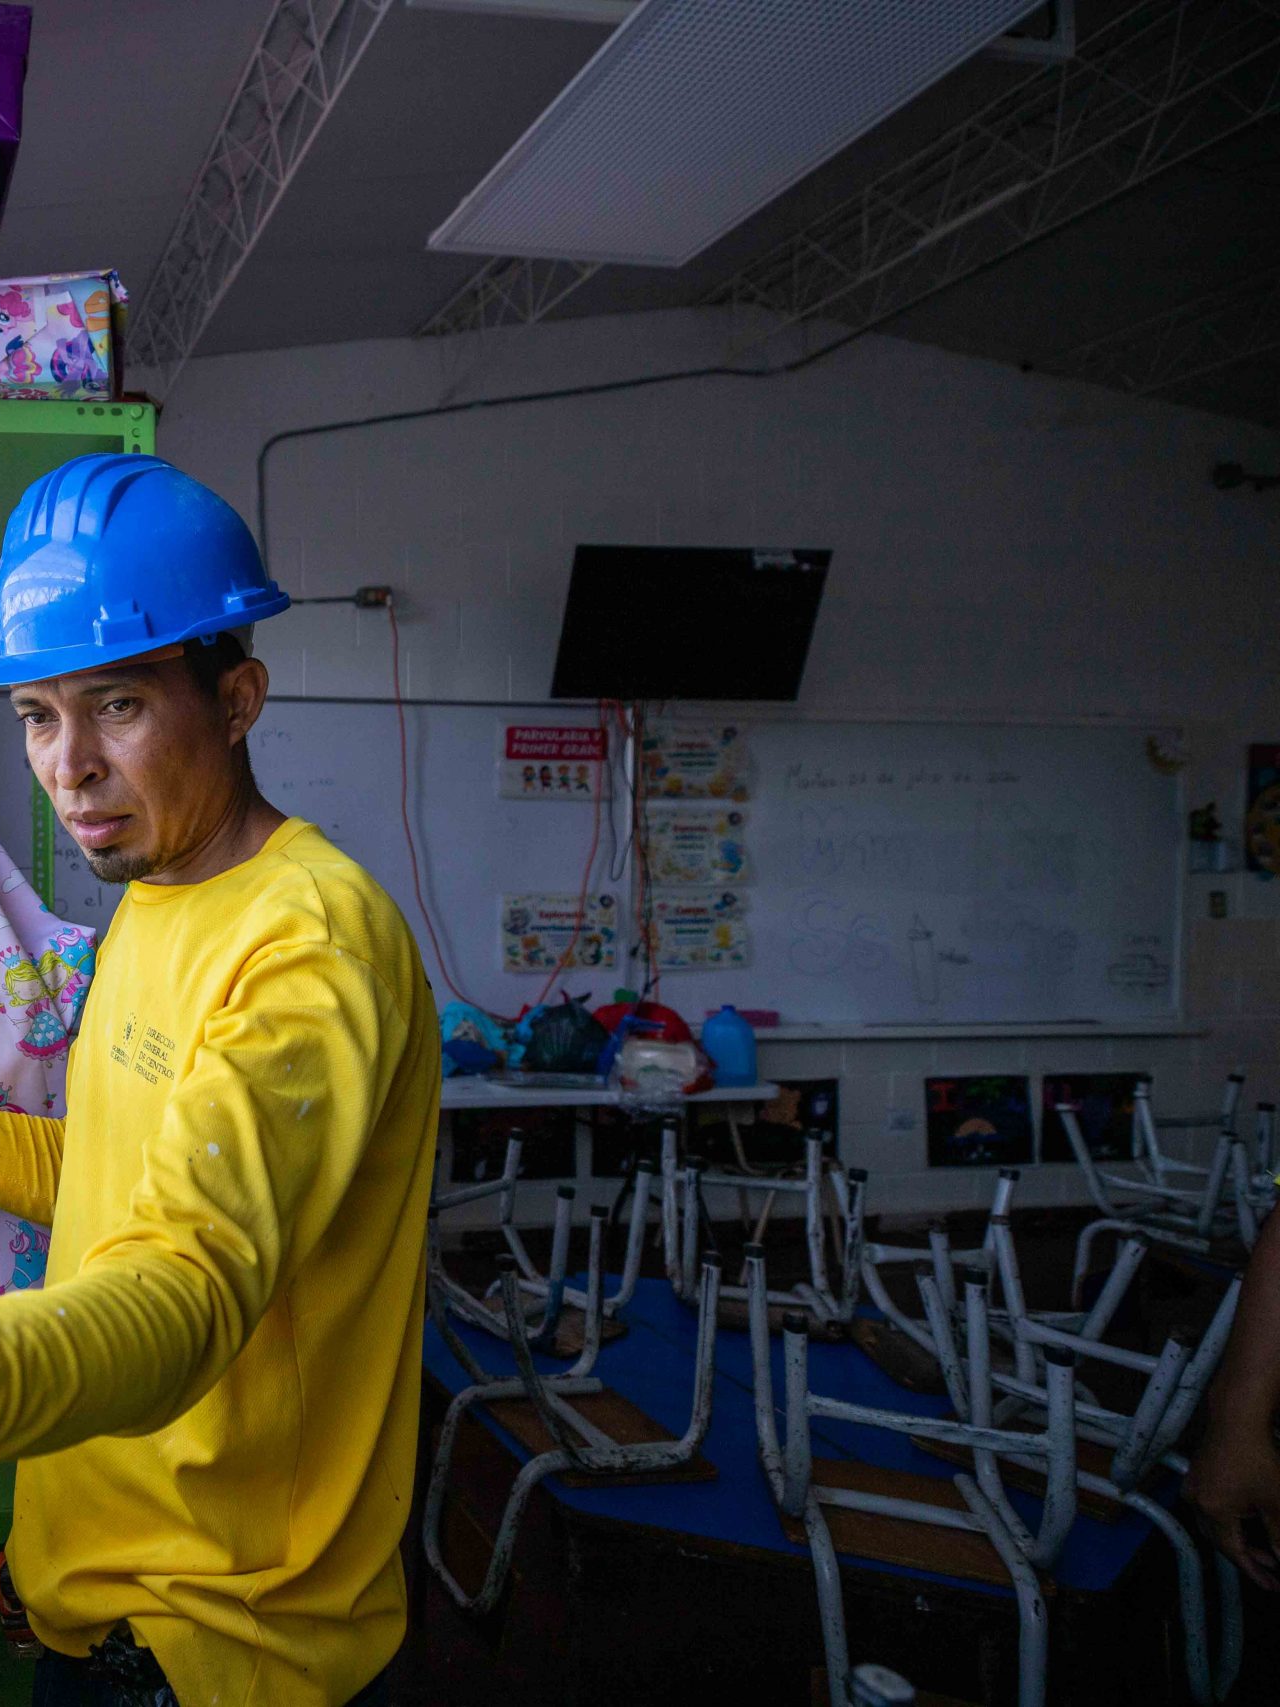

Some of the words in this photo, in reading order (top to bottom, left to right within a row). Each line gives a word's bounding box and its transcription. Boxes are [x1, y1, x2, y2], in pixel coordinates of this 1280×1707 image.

[513, 728, 590, 741] PARVULARIA
[593, 730, 602, 741] Y
[511, 742, 559, 755] PRIMER
[143, 1039, 169, 1062] GENERAL
[134, 1062, 159, 1085] PENALES
[138, 1050, 147, 1062] DE
[146, 1056, 176, 1080] CENTROS
